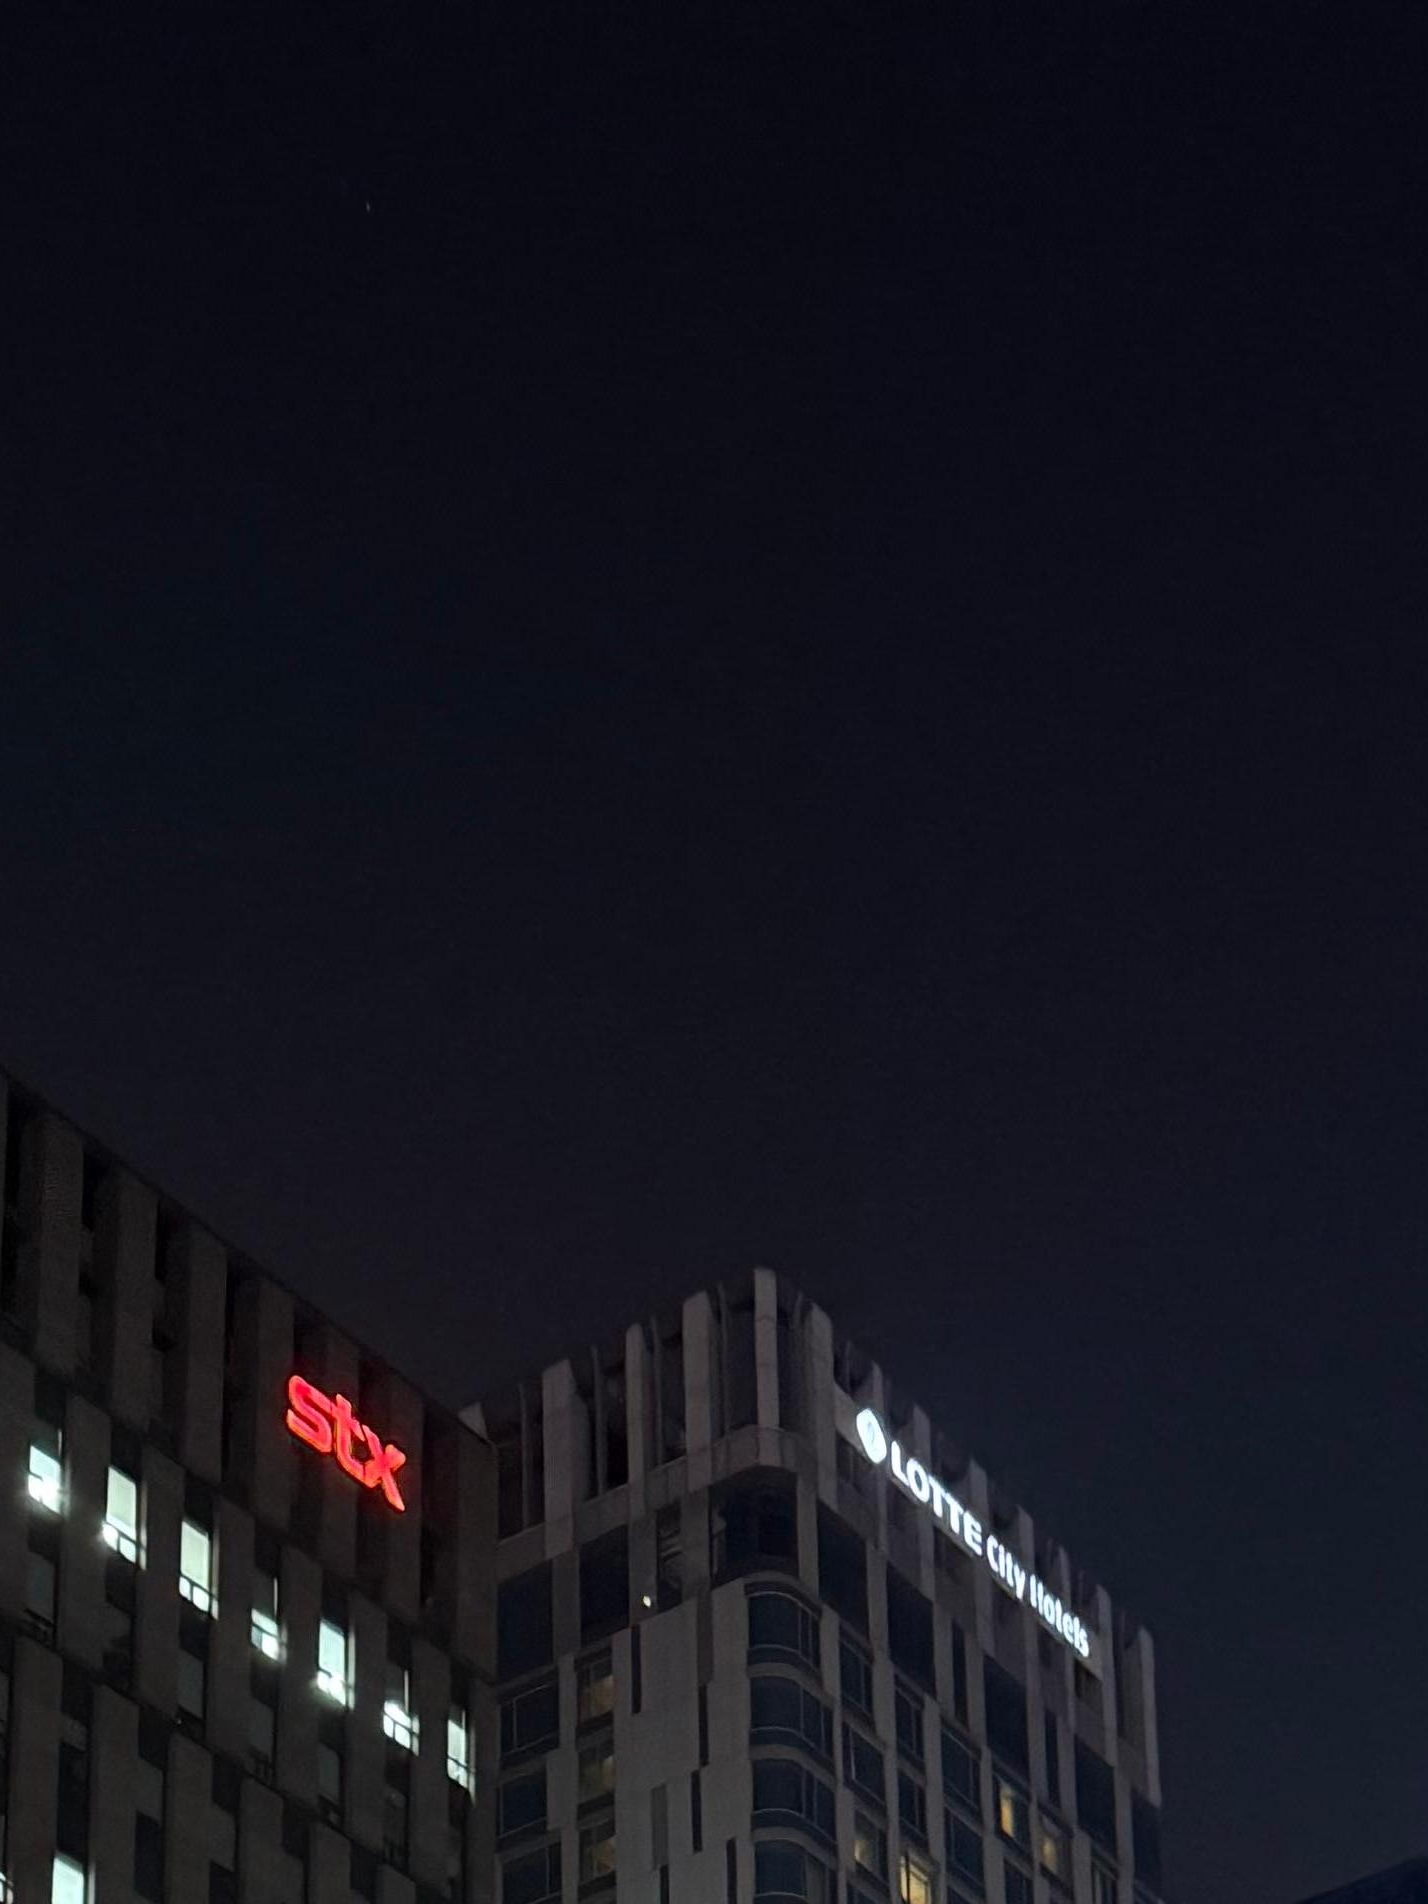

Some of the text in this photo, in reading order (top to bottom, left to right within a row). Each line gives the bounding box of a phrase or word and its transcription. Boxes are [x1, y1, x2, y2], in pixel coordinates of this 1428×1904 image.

[890, 1440, 1090, 1658] LOTTE City Hotels
